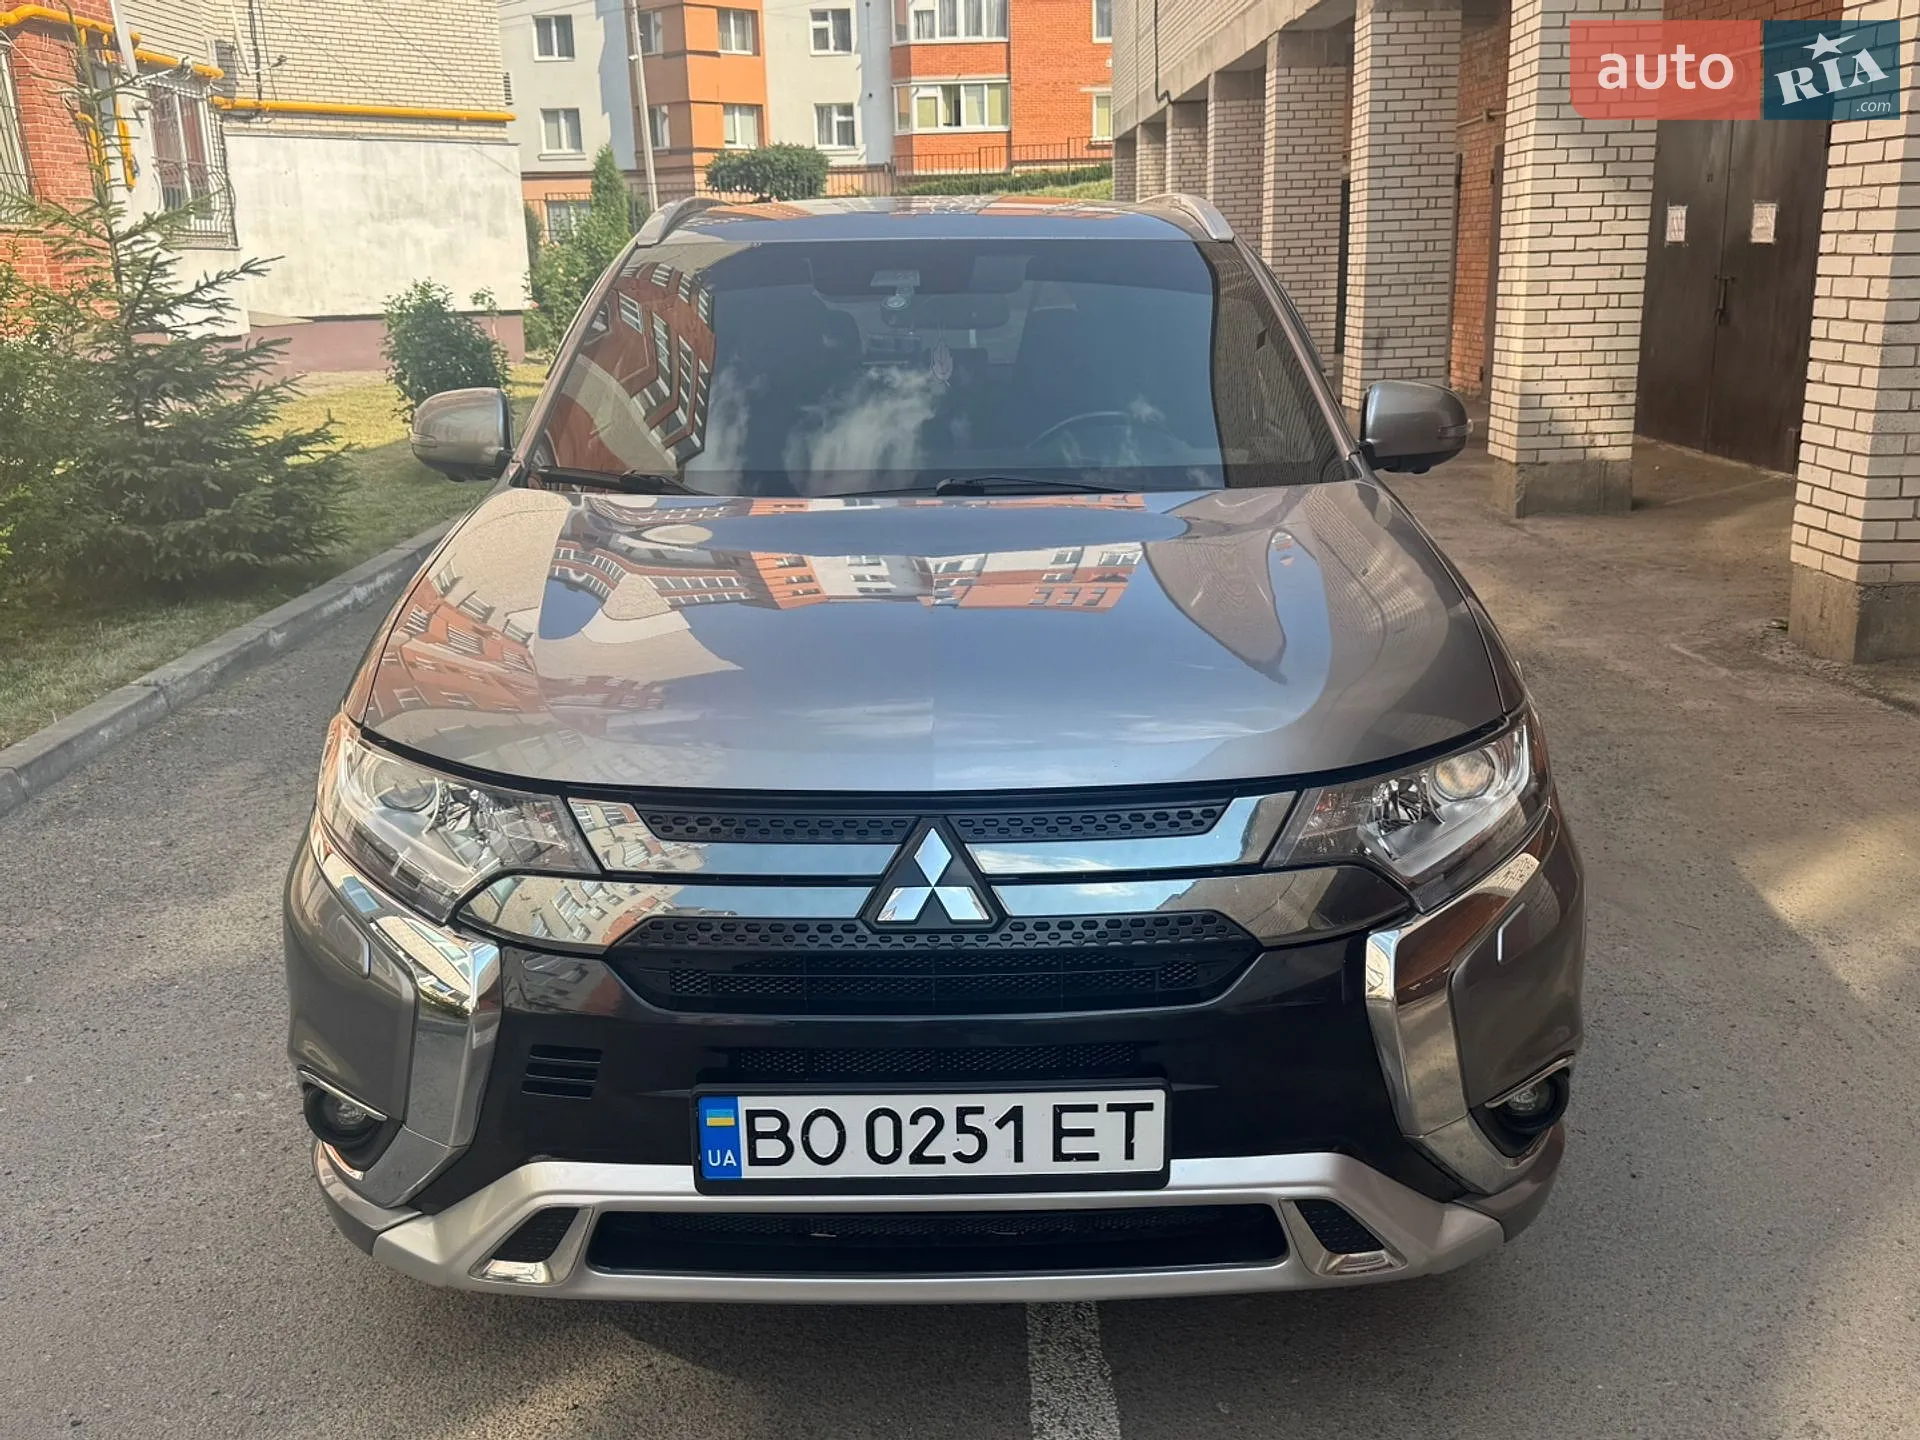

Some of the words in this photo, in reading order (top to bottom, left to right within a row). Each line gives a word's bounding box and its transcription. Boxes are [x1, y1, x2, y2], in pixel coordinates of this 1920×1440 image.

[744, 1107, 847, 1167] BO
[864, 1104, 1024, 1166] 0251
[1052, 1102, 1155, 1163] ET
[707, 1149, 737, 1168] UA
